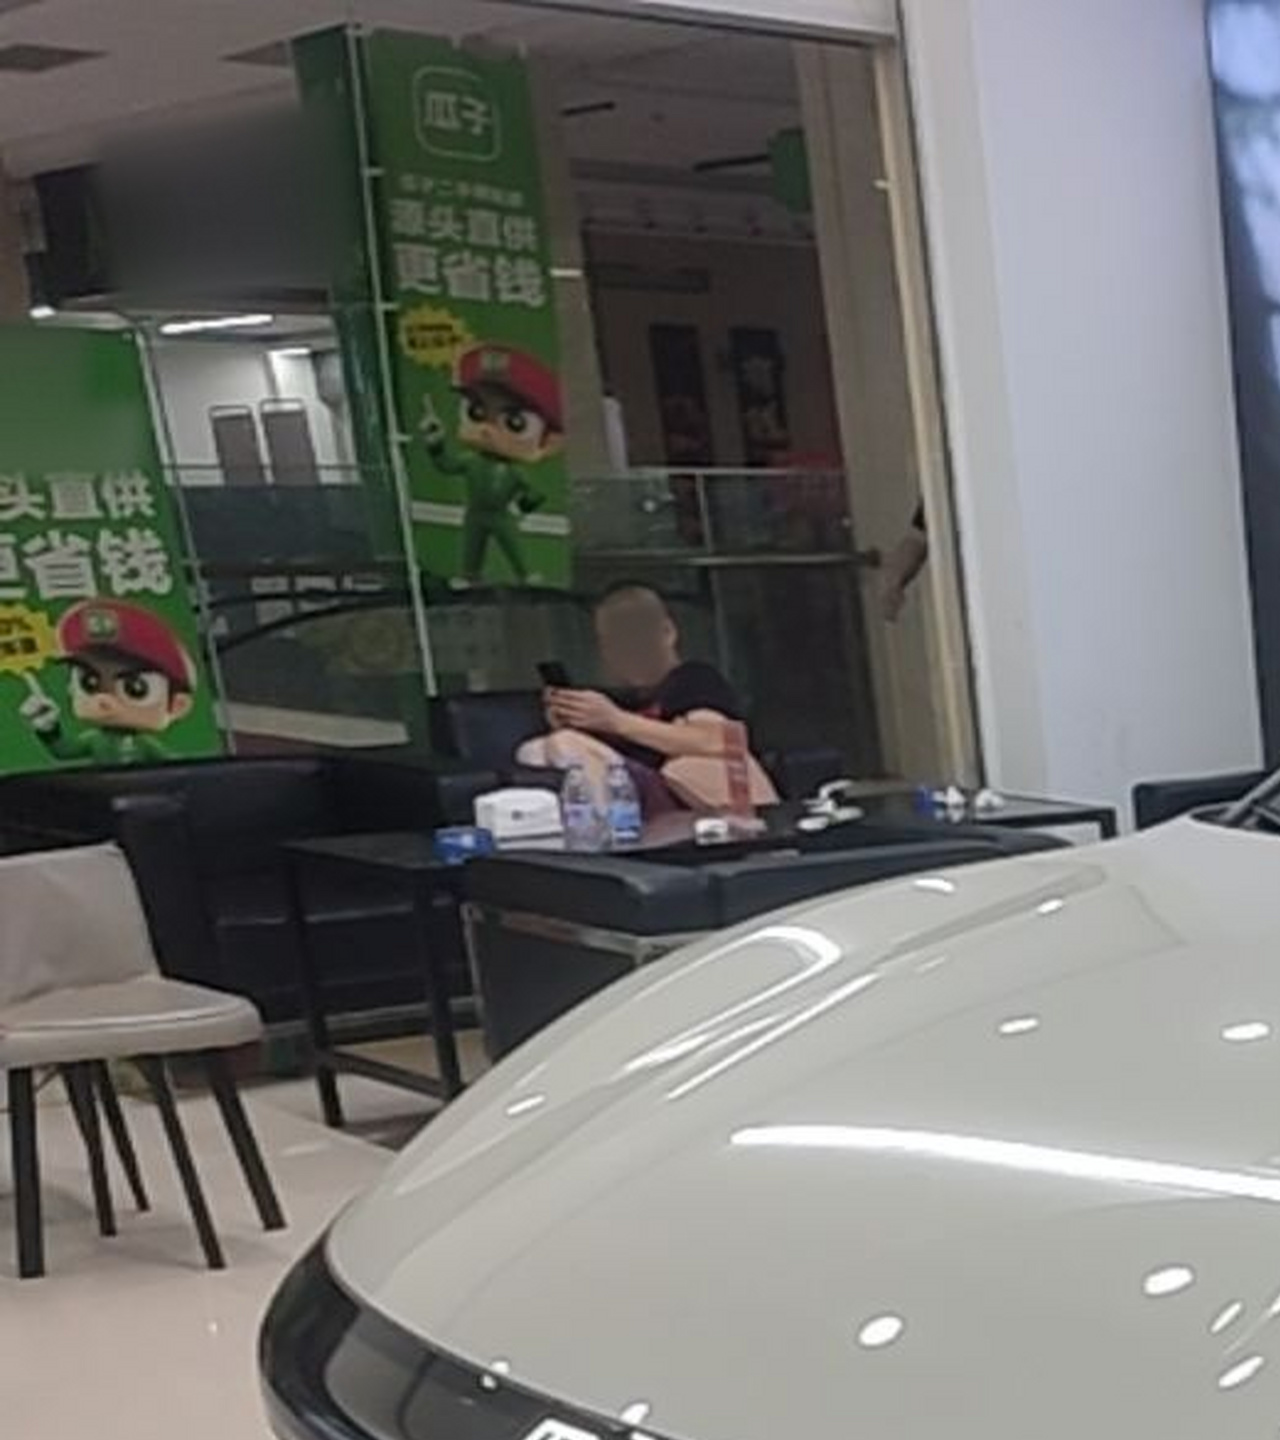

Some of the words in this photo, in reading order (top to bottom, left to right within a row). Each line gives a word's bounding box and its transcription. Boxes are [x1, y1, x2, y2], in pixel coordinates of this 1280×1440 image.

[423, 89, 492, 136] 瓜子
[392, 241, 547, 308] 更省钱
